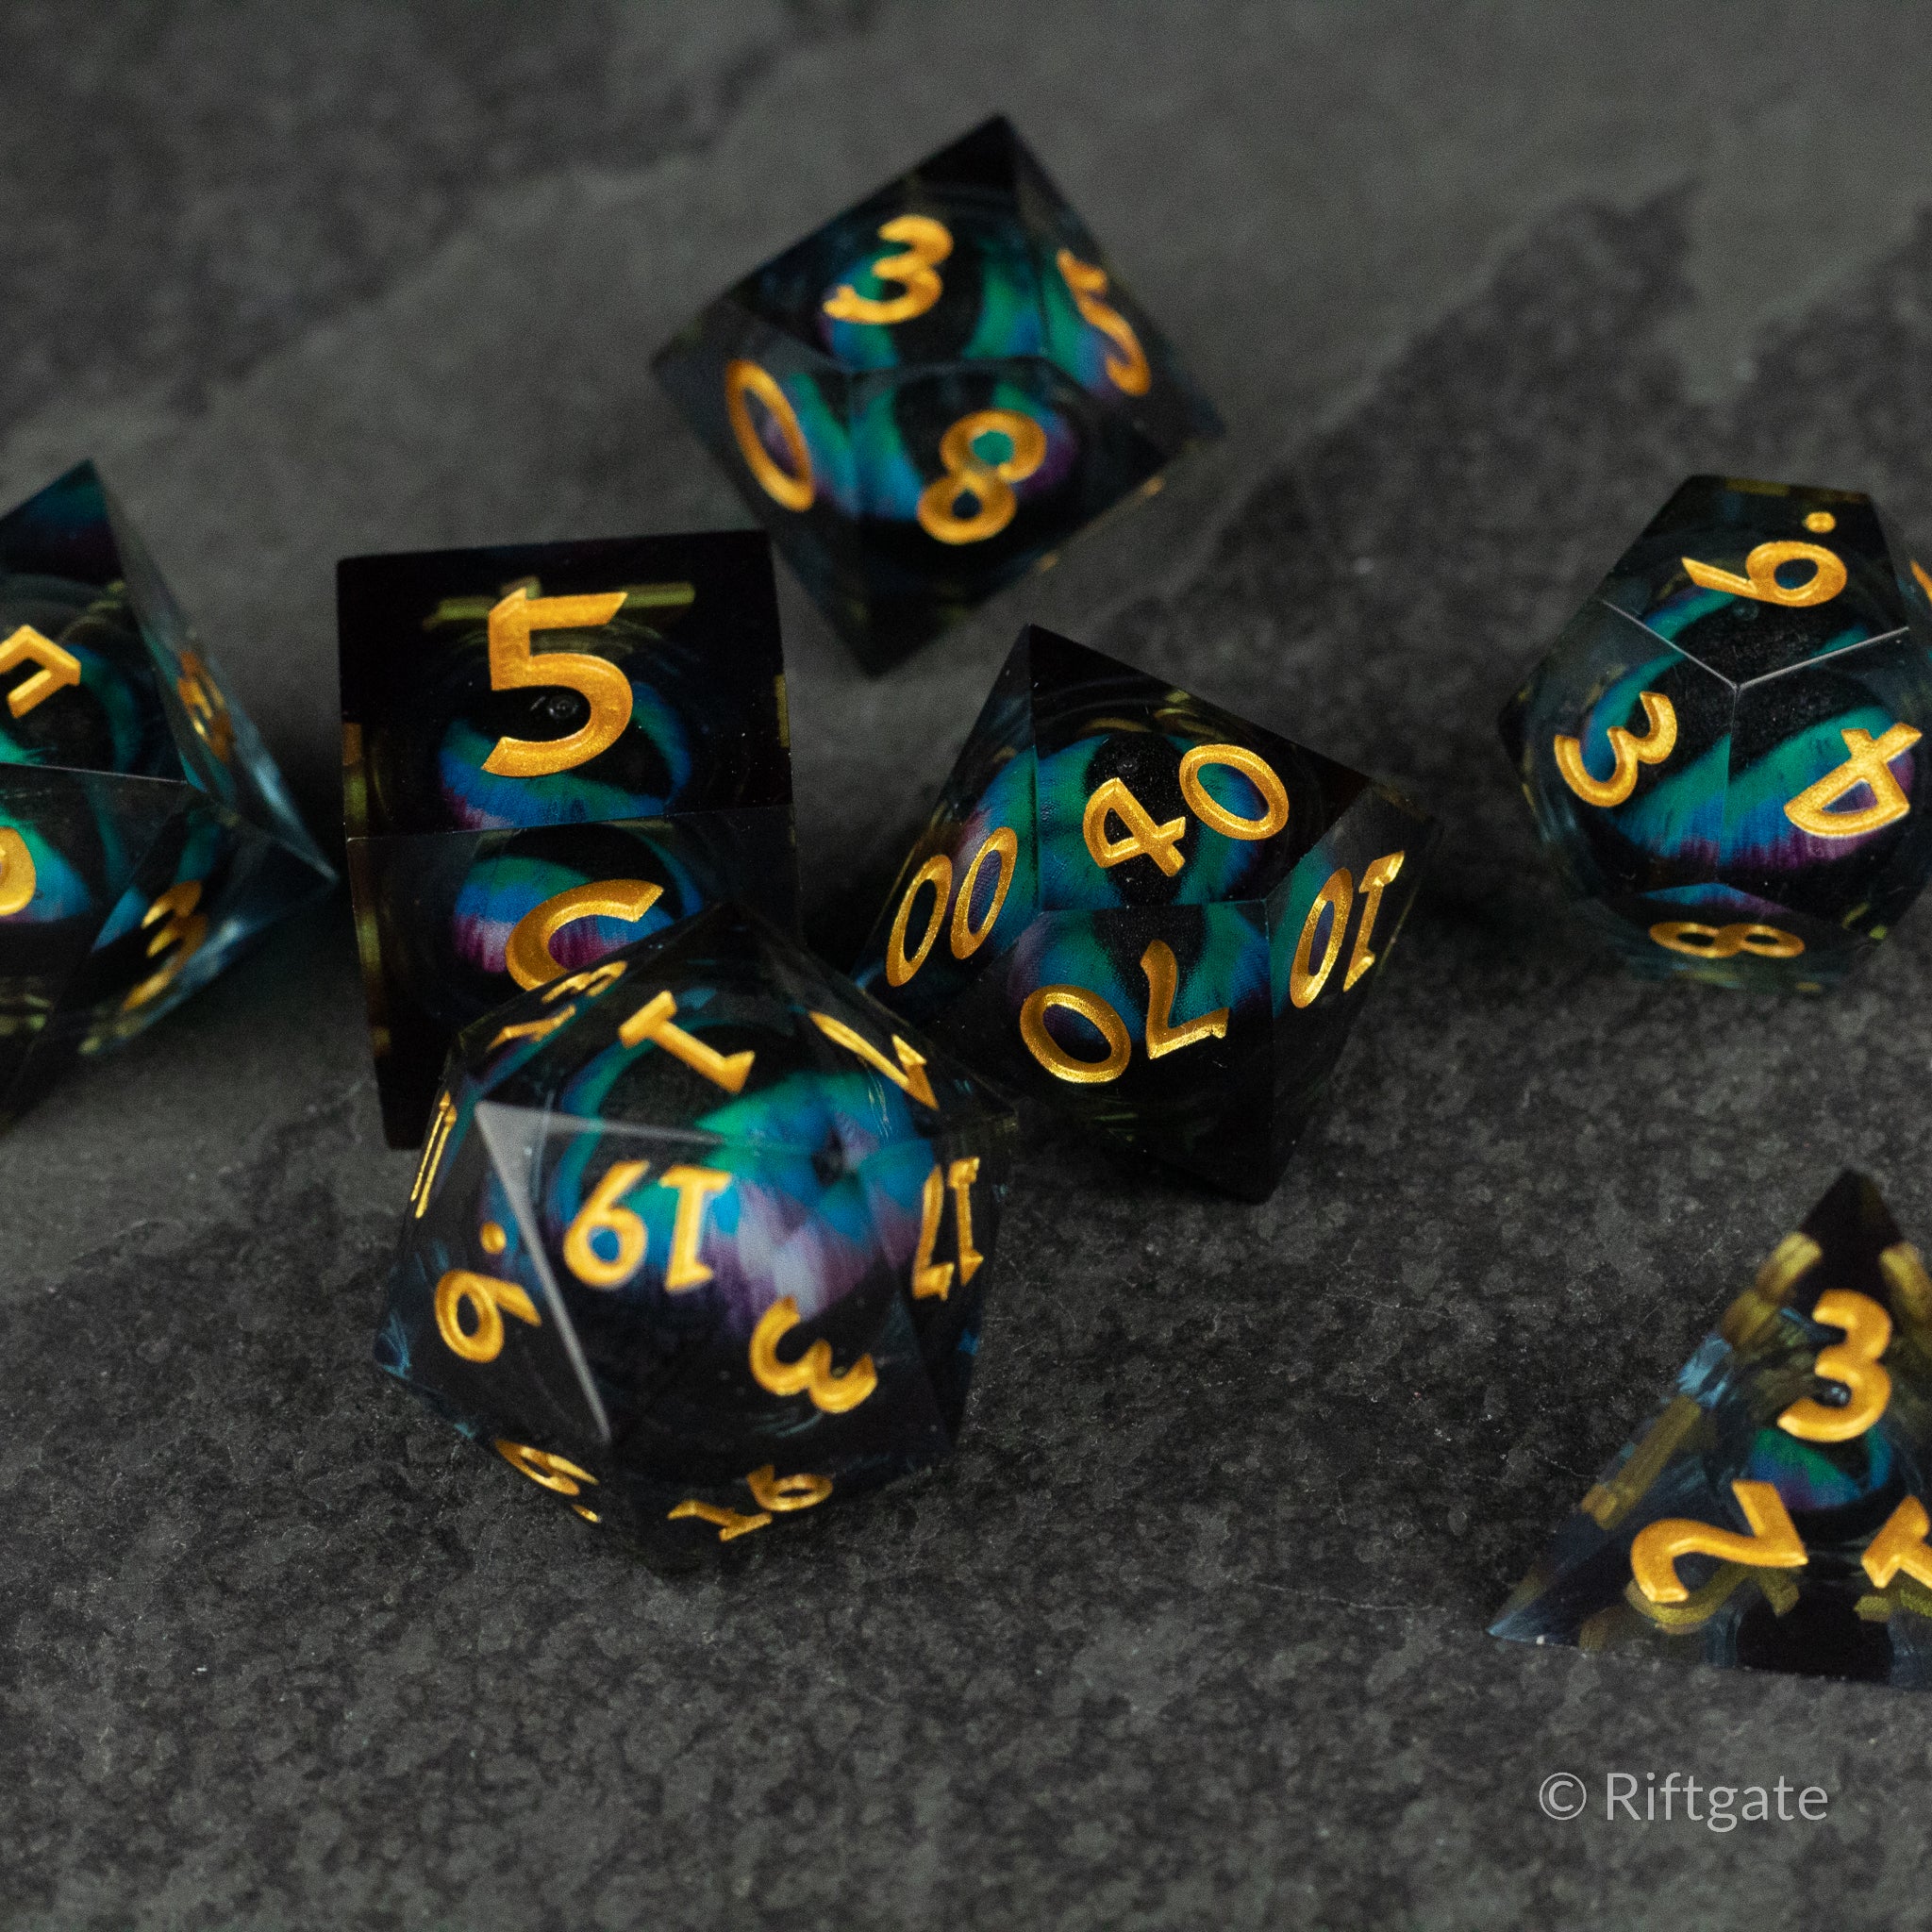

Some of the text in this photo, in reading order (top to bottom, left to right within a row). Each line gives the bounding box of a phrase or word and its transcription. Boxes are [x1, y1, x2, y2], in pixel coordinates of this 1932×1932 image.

[823, 213, 953, 325] 3
[725, 359, 815, 511] 0
[918, 409, 1047, 544] 8
[481, 585, 634, 777] 5
[1083, 742, 1290, 877] 40
[1554, 691, 1678, 808] 3
[1784, 722, 1923, 837] 4
[1649, 922, 1806, 959] 8
[619, 989, 756, 1093] 1
[1019, 940, 1228, 1084] 70
[750, 1296, 878, 1414] 3
[1777, 1289, 1892, 1443] 3
[1630, 1479, 1810, 1603] 2
